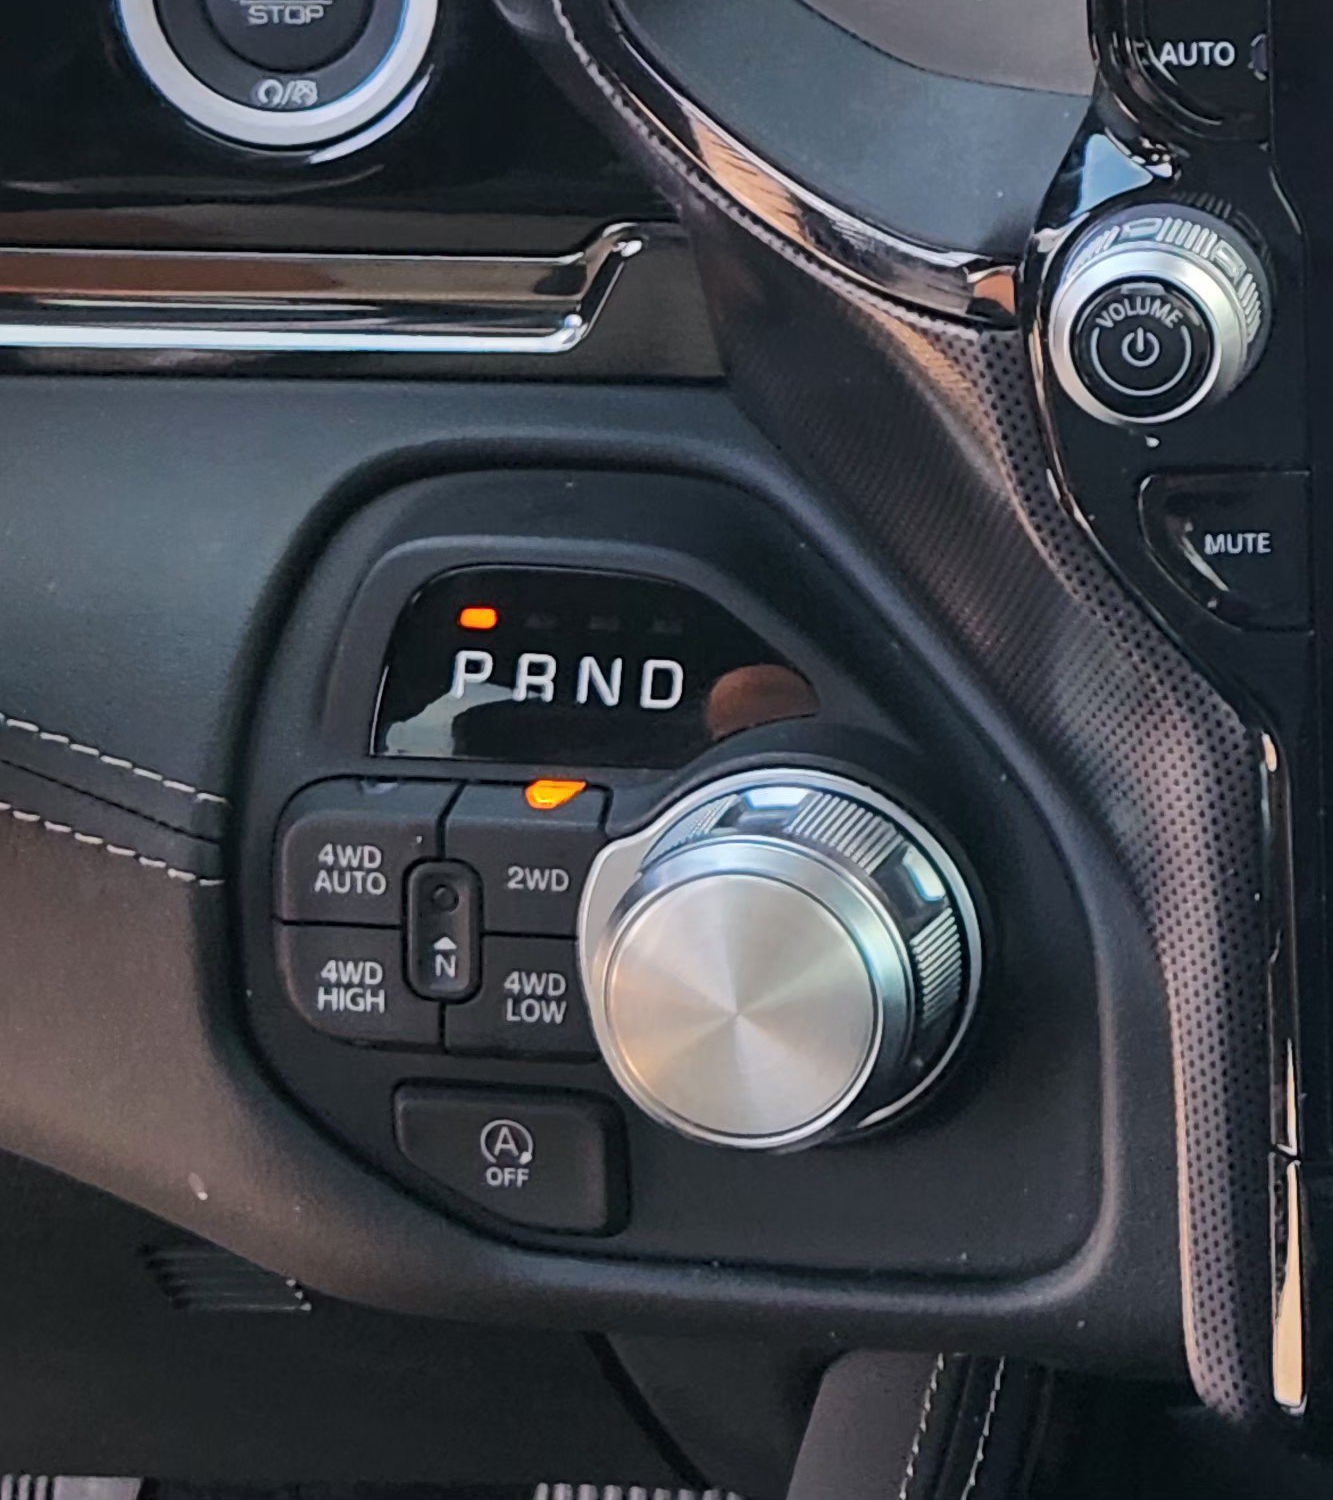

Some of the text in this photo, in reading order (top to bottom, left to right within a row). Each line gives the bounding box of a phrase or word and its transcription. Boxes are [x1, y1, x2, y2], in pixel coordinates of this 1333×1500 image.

[248, 5, 324, 25] STOP
[1160, 41, 1235, 67] AUTO
[1095, 296, 1185, 329] VOLUME
[1204, 532, 1272, 555] MUTE
[318, 844, 382, 870] 4WD
[314, 870, 387, 896] AUTO
[507, 866, 569, 893] 2WD
[320, 960, 384, 986] 4WD
[435, 954, 456, 979] N
[504, 971, 566, 997] 4WD
[317, 987, 386, 1014] HIGH
[506, 998, 567, 1025] LOW
[486, 1166, 530, 1188] OFF
